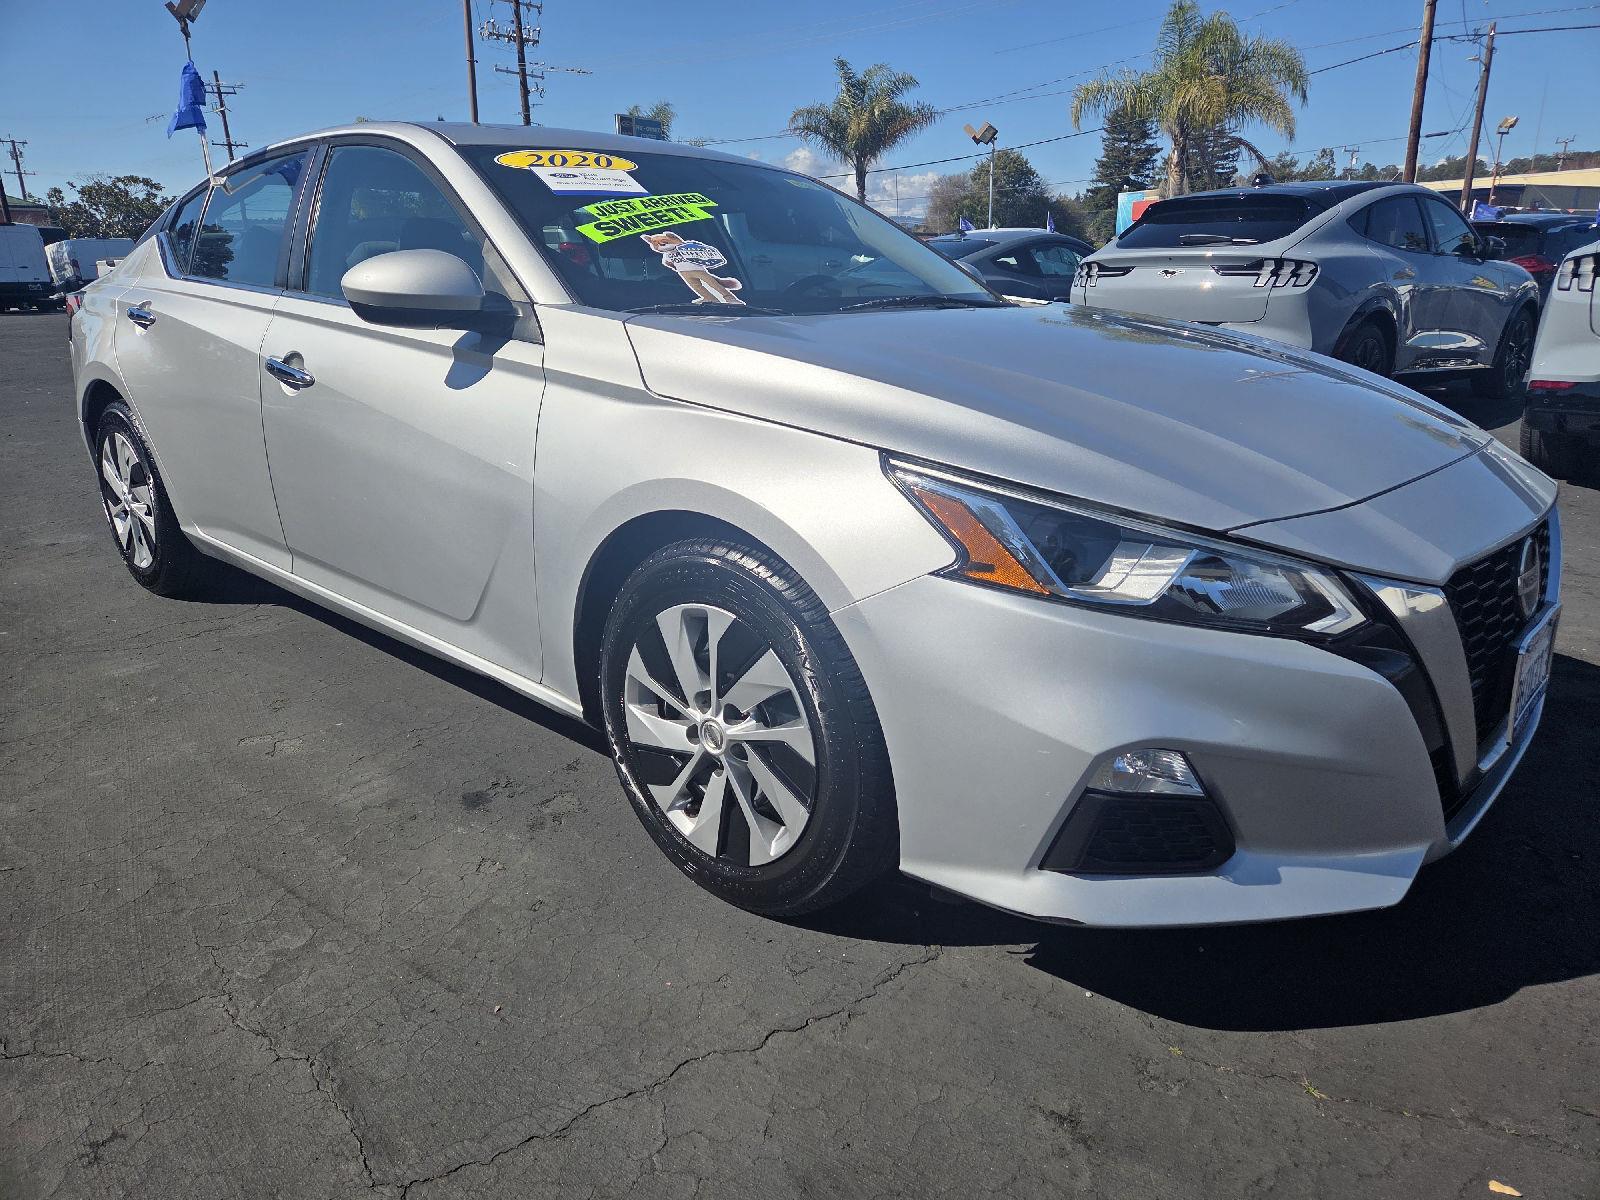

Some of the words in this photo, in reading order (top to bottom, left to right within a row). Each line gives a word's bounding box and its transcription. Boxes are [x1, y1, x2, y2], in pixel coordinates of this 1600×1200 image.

[527, 153, 612, 168] 2020
[594, 201, 637, 217] JUST
[640, 194, 710, 210] ARRIVED
[593, 206, 696, 236] SWEET!
